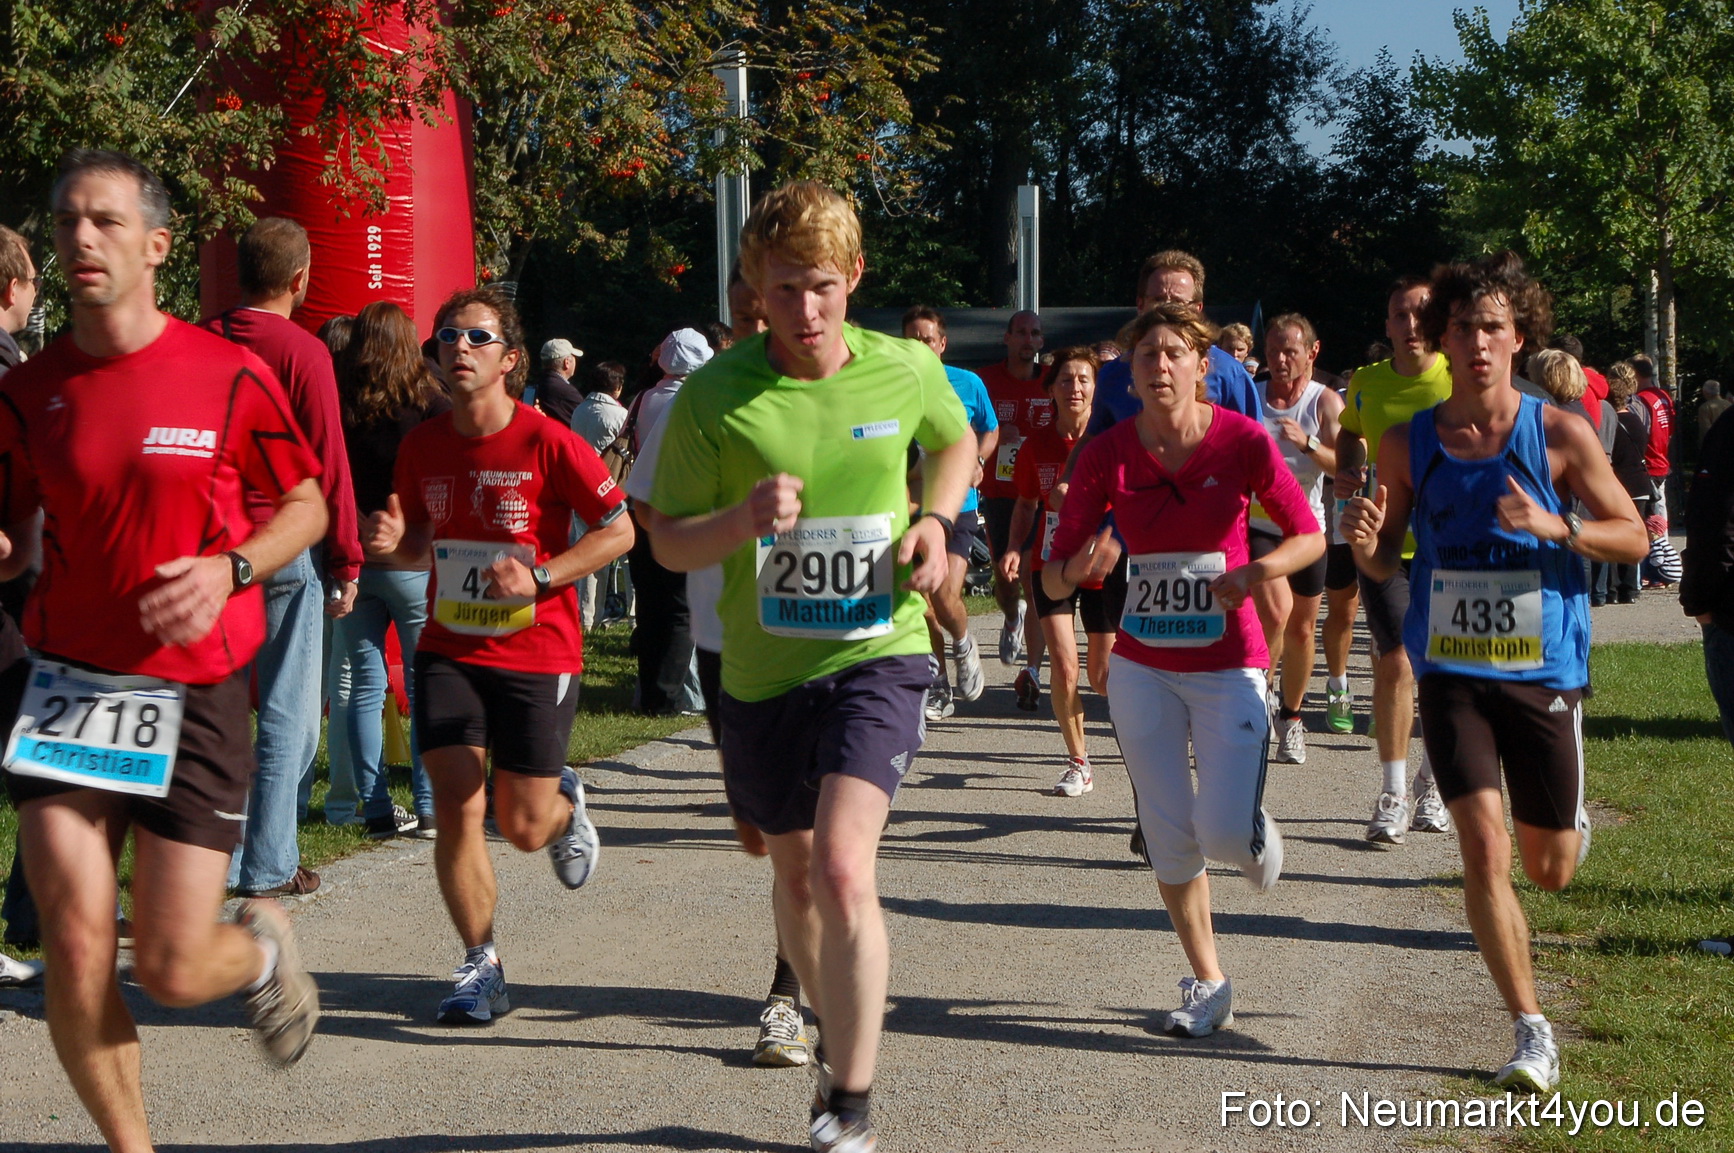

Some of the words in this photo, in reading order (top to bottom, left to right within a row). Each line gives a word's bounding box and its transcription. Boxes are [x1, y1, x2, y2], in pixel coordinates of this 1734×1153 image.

[367, 225, 382, 259] 1929
[368, 263, 382, 289] Seit
[142, 426, 217, 449] JURA
[478, 478, 522, 487] STADTLAUF
[480, 470, 533, 480] NEUMARKTER
[774, 549, 876, 595] 2901
[1136, 577, 1213, 613] 2490
[454, 602, 511, 625] Jürgen
[780, 599, 877, 623] Matthias
[1451, 598, 1516, 634] 433
[1139, 616, 1208, 635] Theresa
[1440, 636, 1530, 660] Christoph
[37, 695, 160, 749] 2718
[32, 740, 151, 777] Christian
